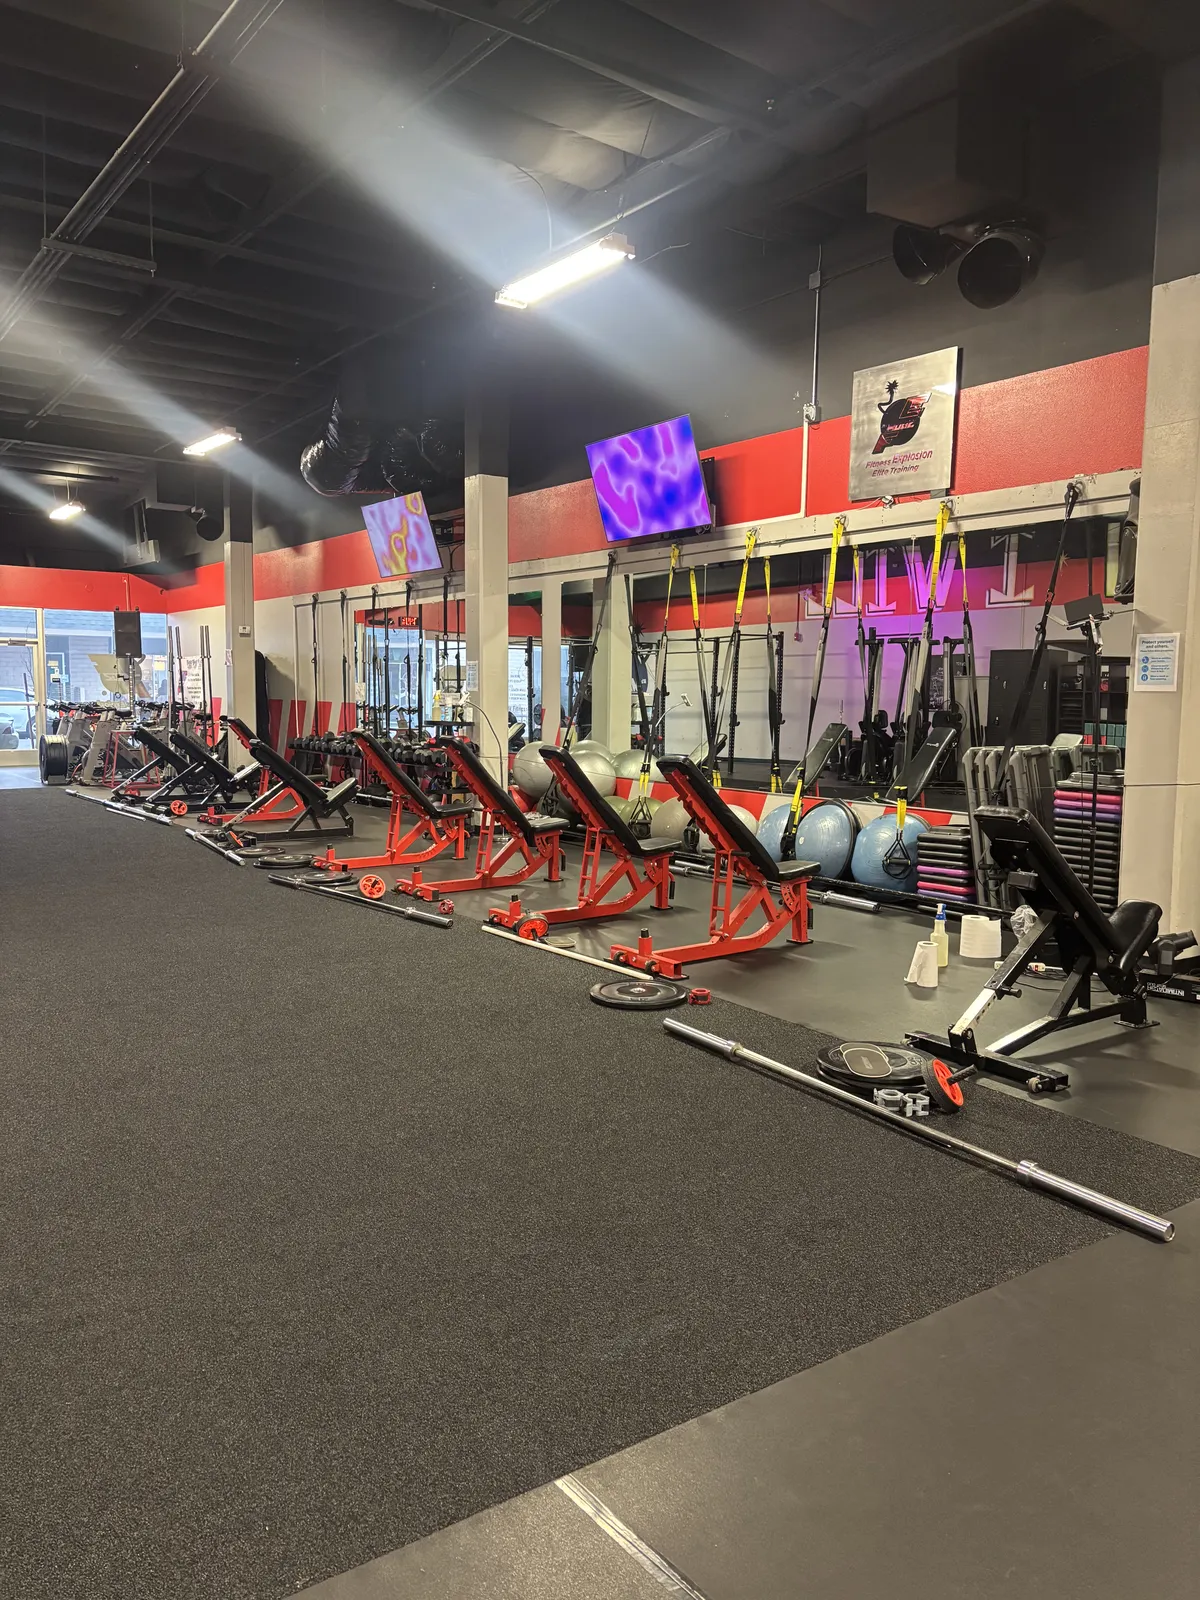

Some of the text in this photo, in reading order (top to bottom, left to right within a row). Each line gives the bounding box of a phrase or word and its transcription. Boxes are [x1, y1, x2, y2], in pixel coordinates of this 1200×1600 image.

[866, 450, 933, 468] Fitness Explosion
[872, 465, 919, 477] Elite Training
